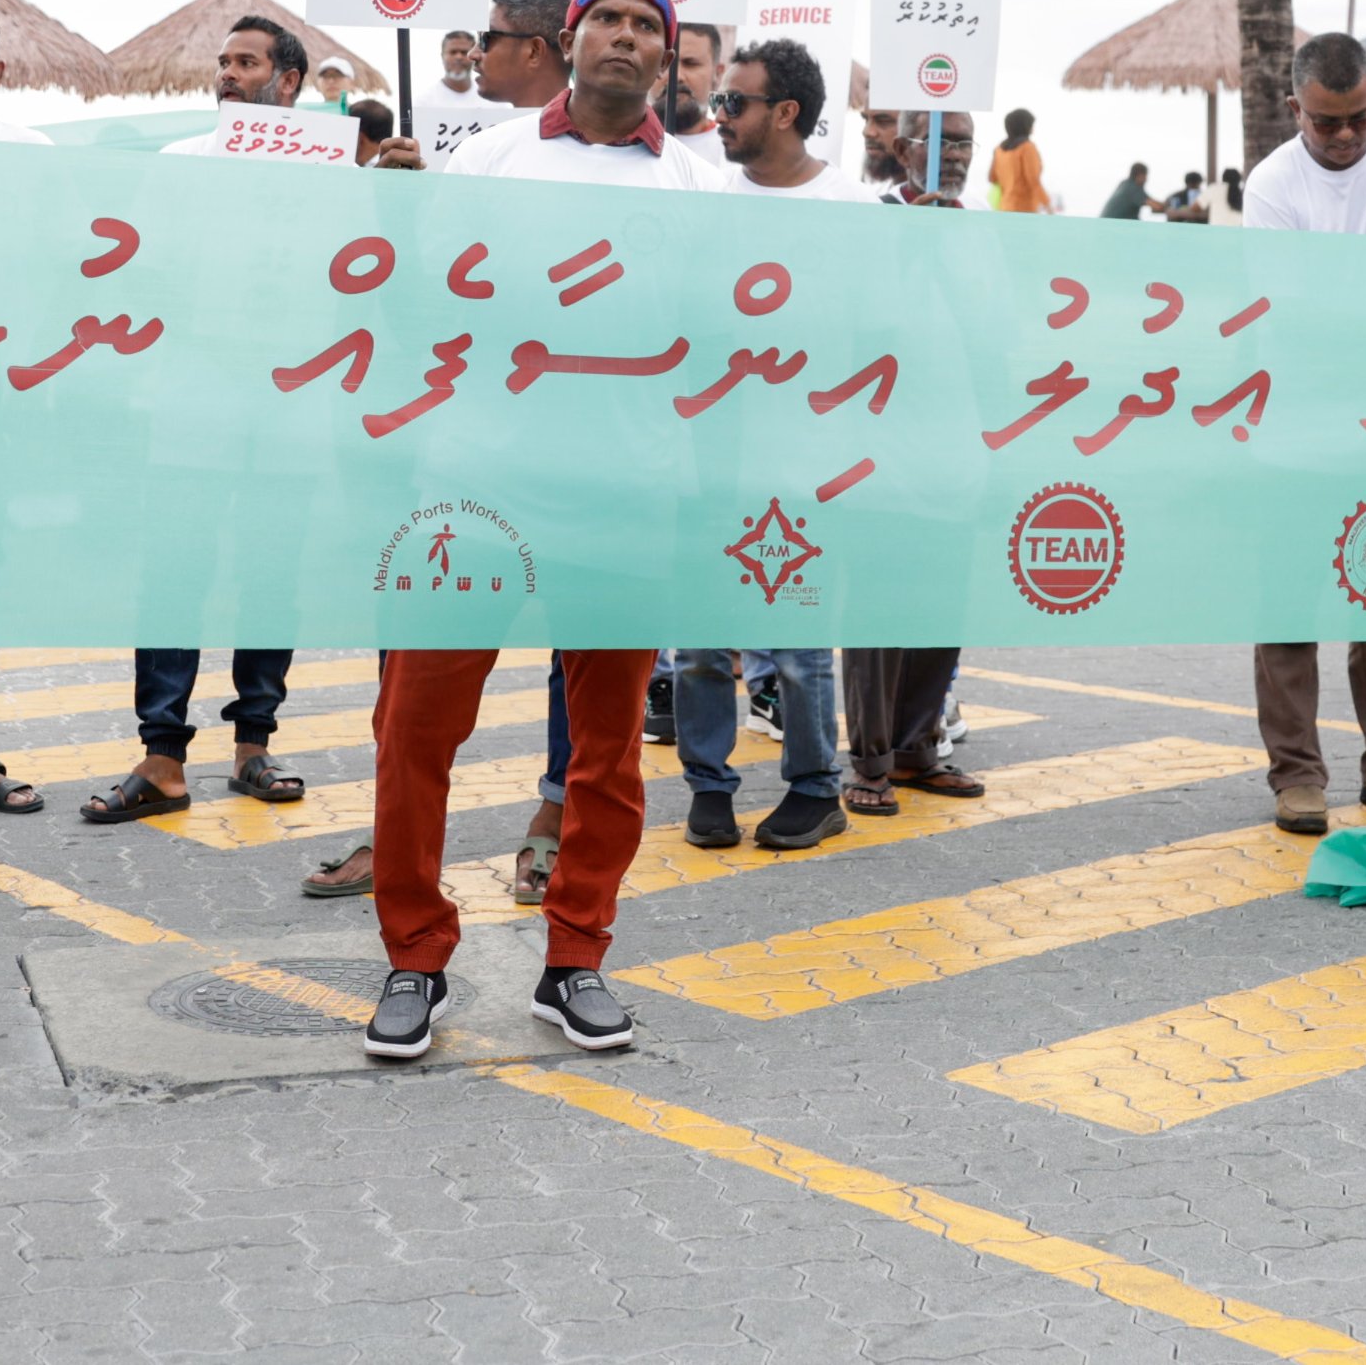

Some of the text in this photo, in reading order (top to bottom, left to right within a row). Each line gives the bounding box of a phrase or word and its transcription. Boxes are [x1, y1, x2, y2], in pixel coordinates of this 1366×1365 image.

[759, 7, 833, 27] SERVICE
[925, 71, 953, 81] TEAM
[373, 498, 538, 594] Maldives Ports Workers Union
[756, 544, 791, 558] TAM
[1025, 536, 1109, 563] TEAM
